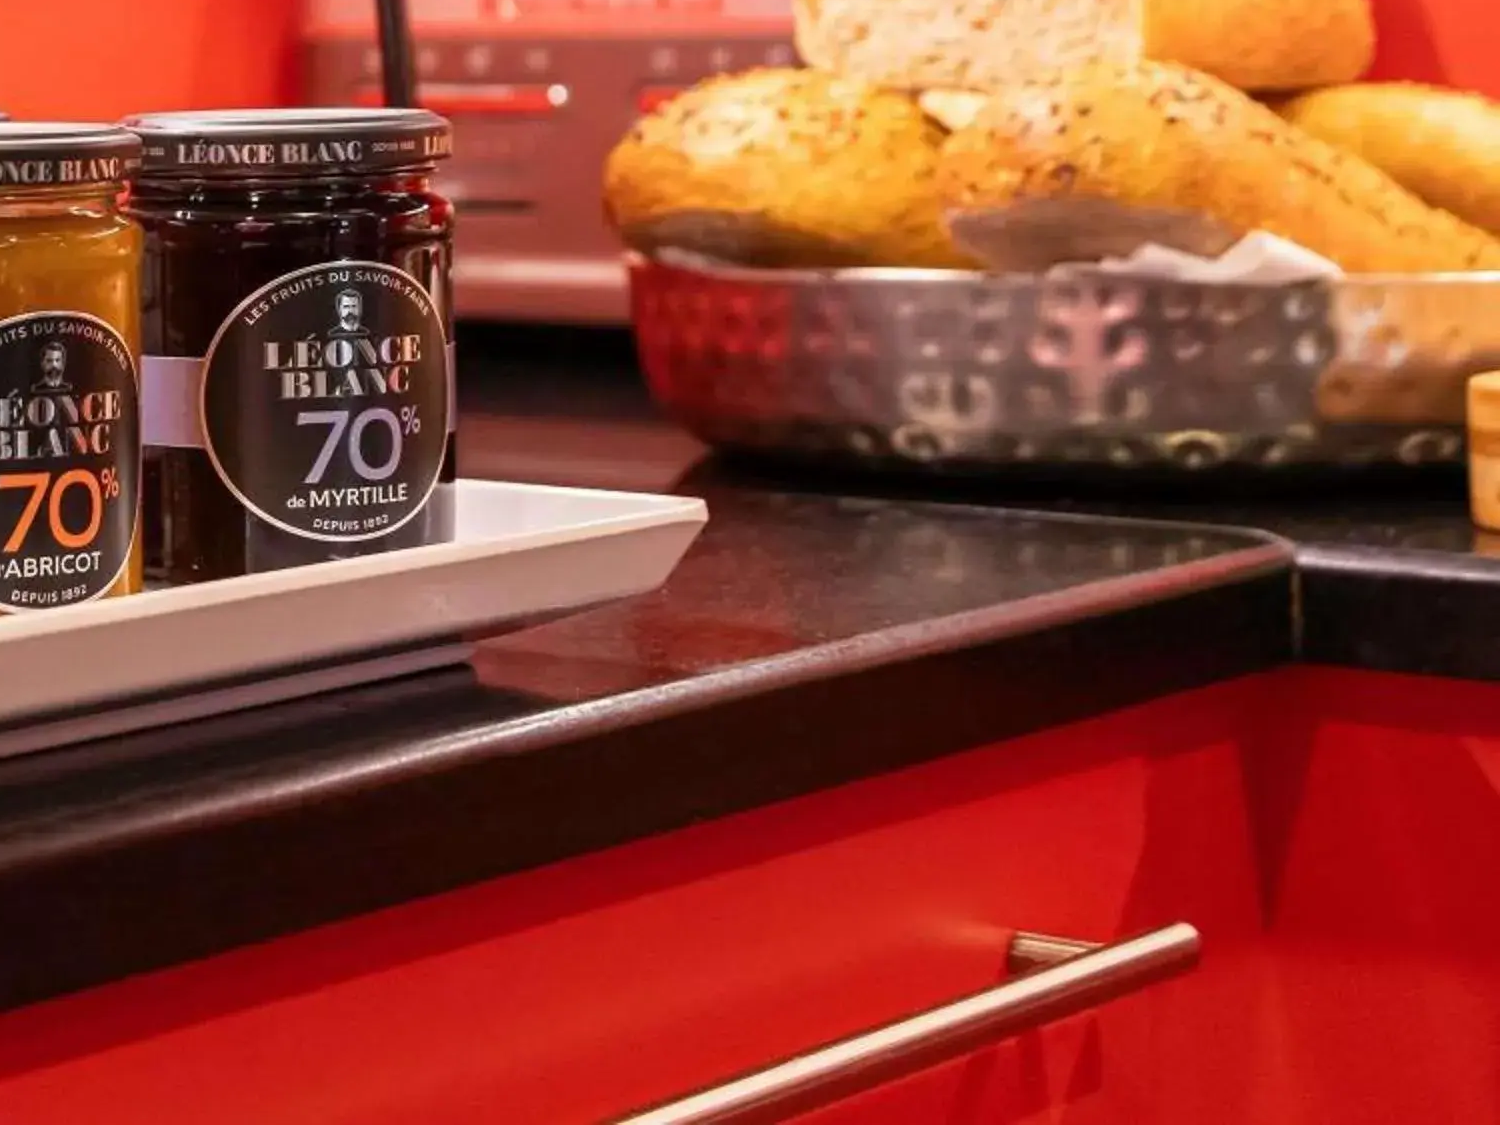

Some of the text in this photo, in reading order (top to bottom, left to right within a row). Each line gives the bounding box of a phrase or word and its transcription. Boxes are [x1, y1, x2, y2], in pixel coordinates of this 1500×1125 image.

[177, 138, 275, 164] LÉONCE
[280, 140, 362, 164] BLANC
[60, 158, 120, 182] BLANC
[244, 302, 270, 326] LES
[272, 276, 325, 305] FRUITS
[328, 271, 349, 284] DU
[32, 322, 54, 337] DU
[263, 333, 421, 370] LÉONCE
[280, 365, 409, 400] BLANC
[287, 483, 408, 509] de MYRTILLE
[313, 518, 359, 532] DEPUIS
[11, 589, 58, 604] DEPUIS
